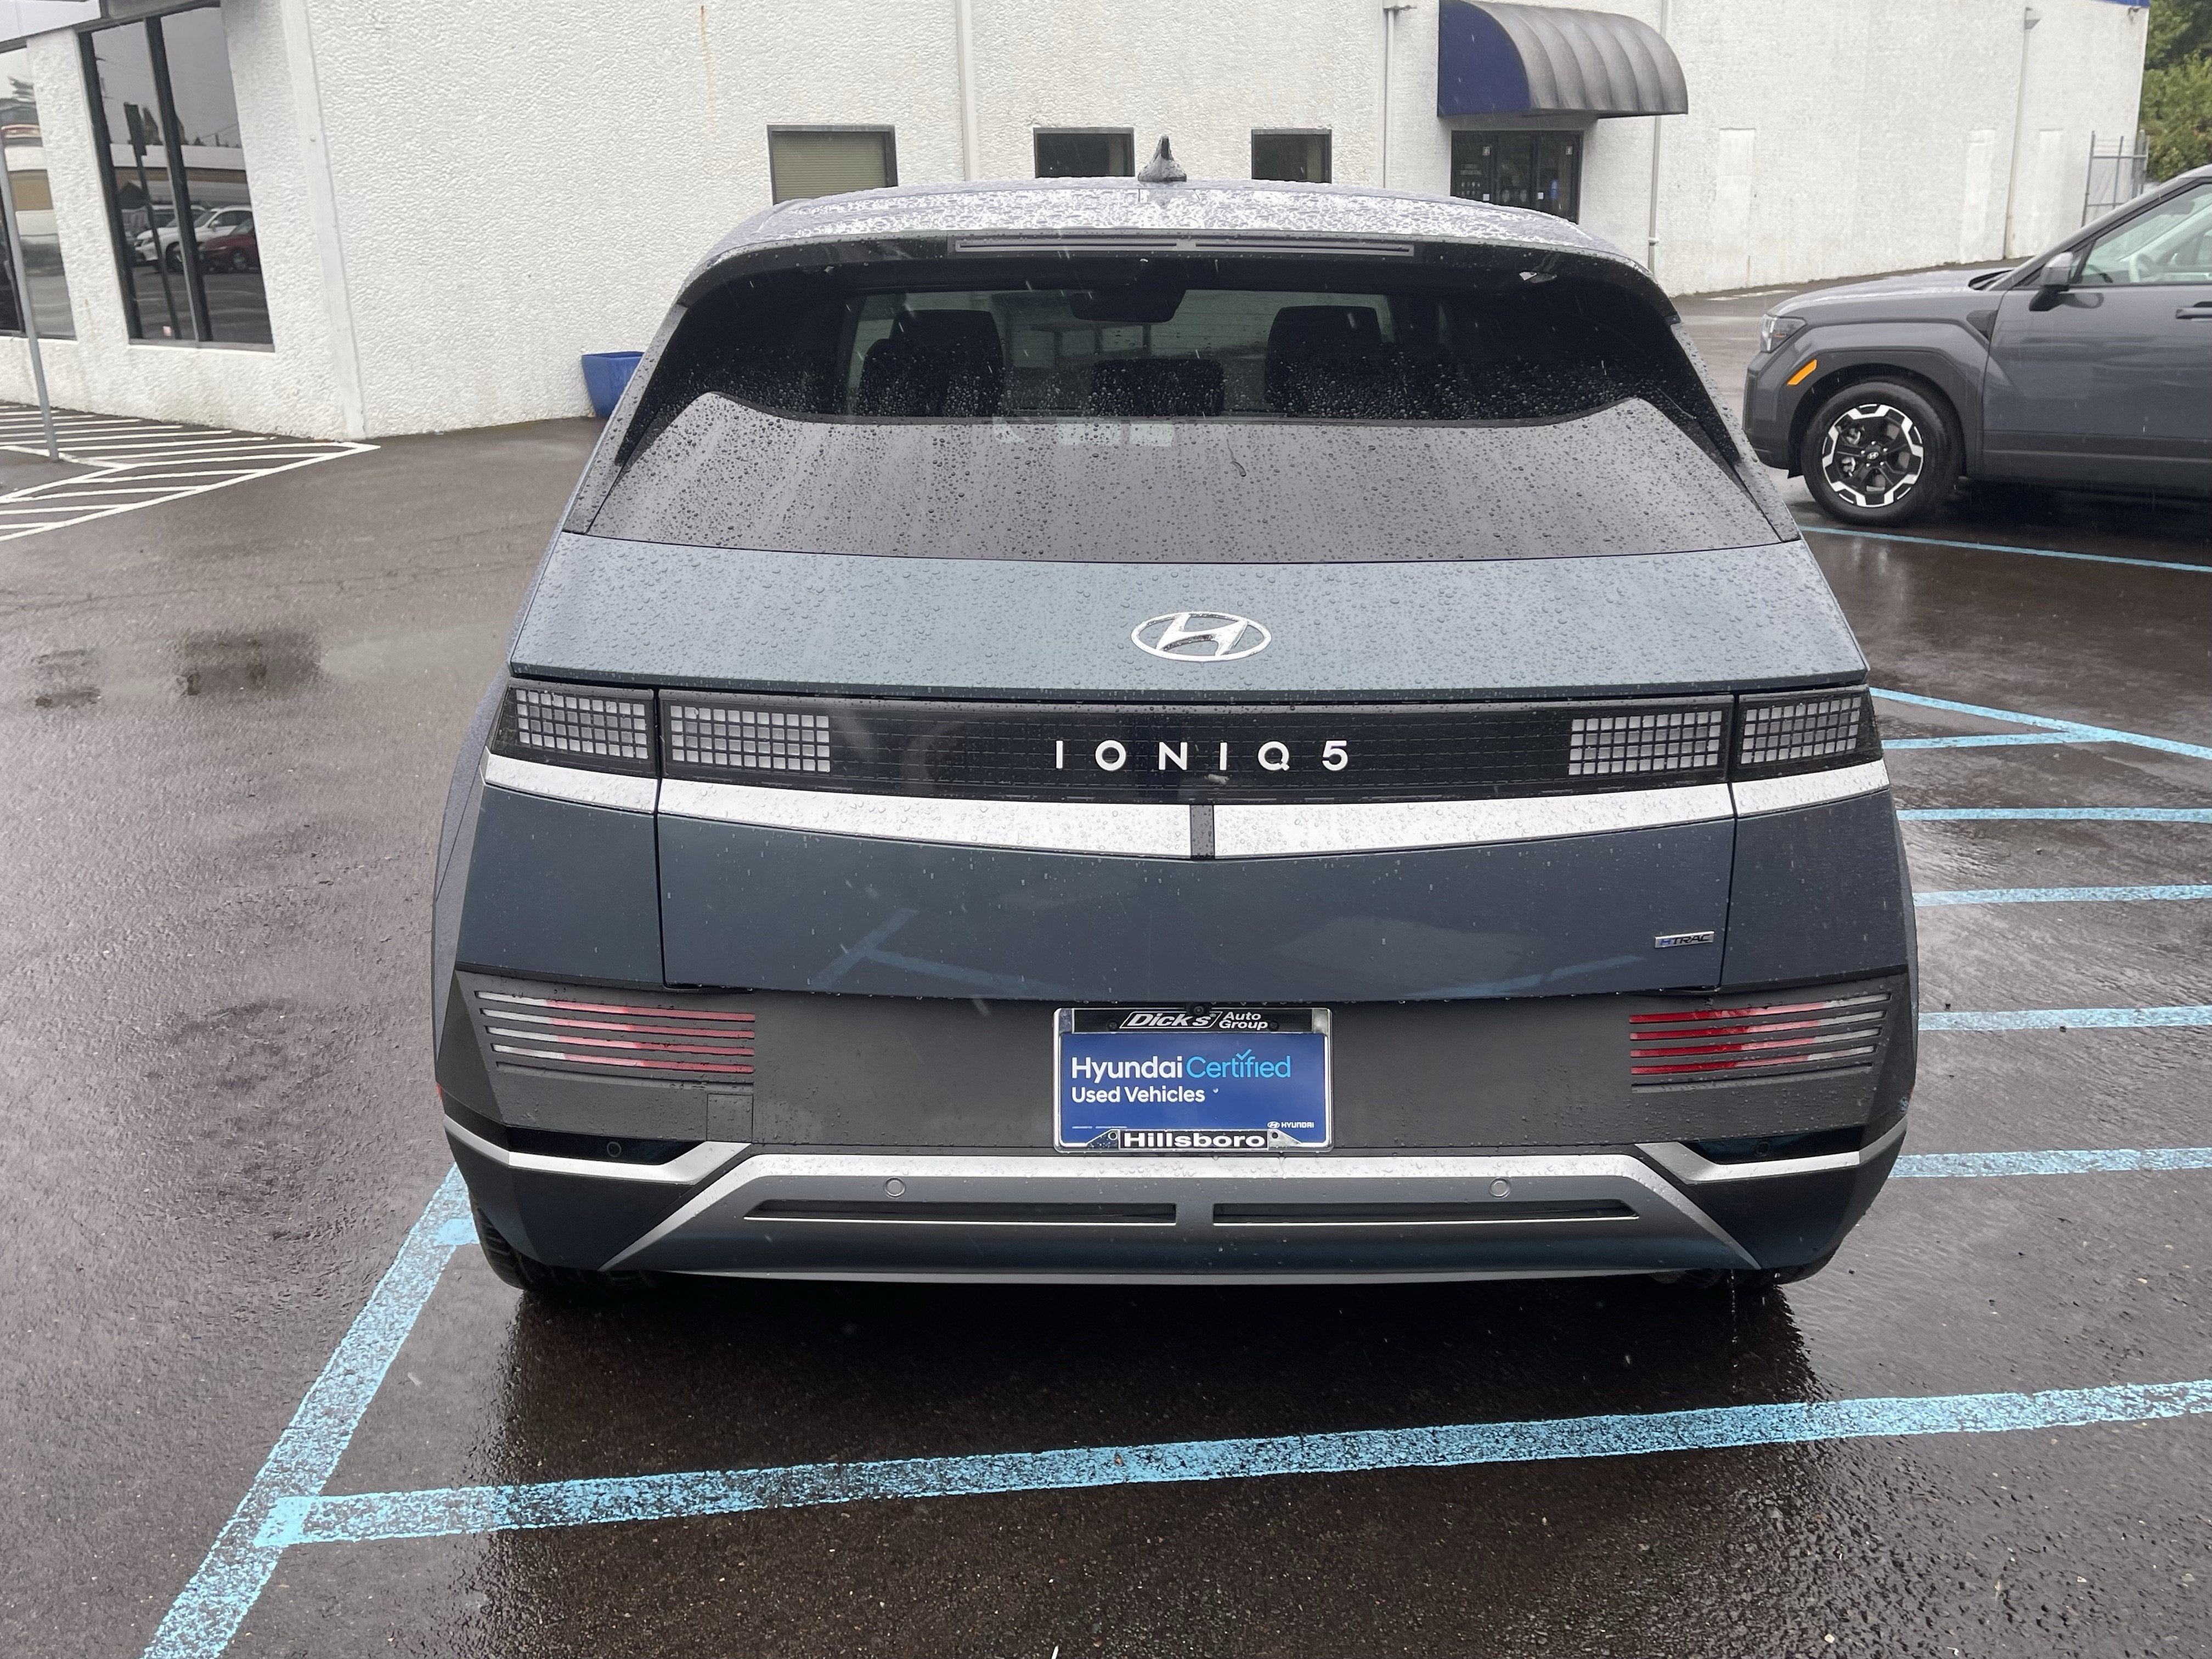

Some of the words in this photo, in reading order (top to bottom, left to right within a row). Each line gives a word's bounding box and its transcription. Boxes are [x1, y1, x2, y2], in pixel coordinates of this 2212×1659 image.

[1056, 740, 1290, 771] IONIQ
[1322, 740, 1348, 771] 5
[1660, 934, 1710, 946] HTRAC
[1223, 1012, 1261, 1021] Auto
[1218, 1019, 1268, 1030] Group
[1071, 1056, 1182, 1083] Hyundai
[1186, 1049, 1291, 1078] Certified
[1071, 1086, 1120, 1103] Used
[1124, 1086, 1205, 1103] Vehicles
[1124, 1132, 1265, 1147] Hillsboro
